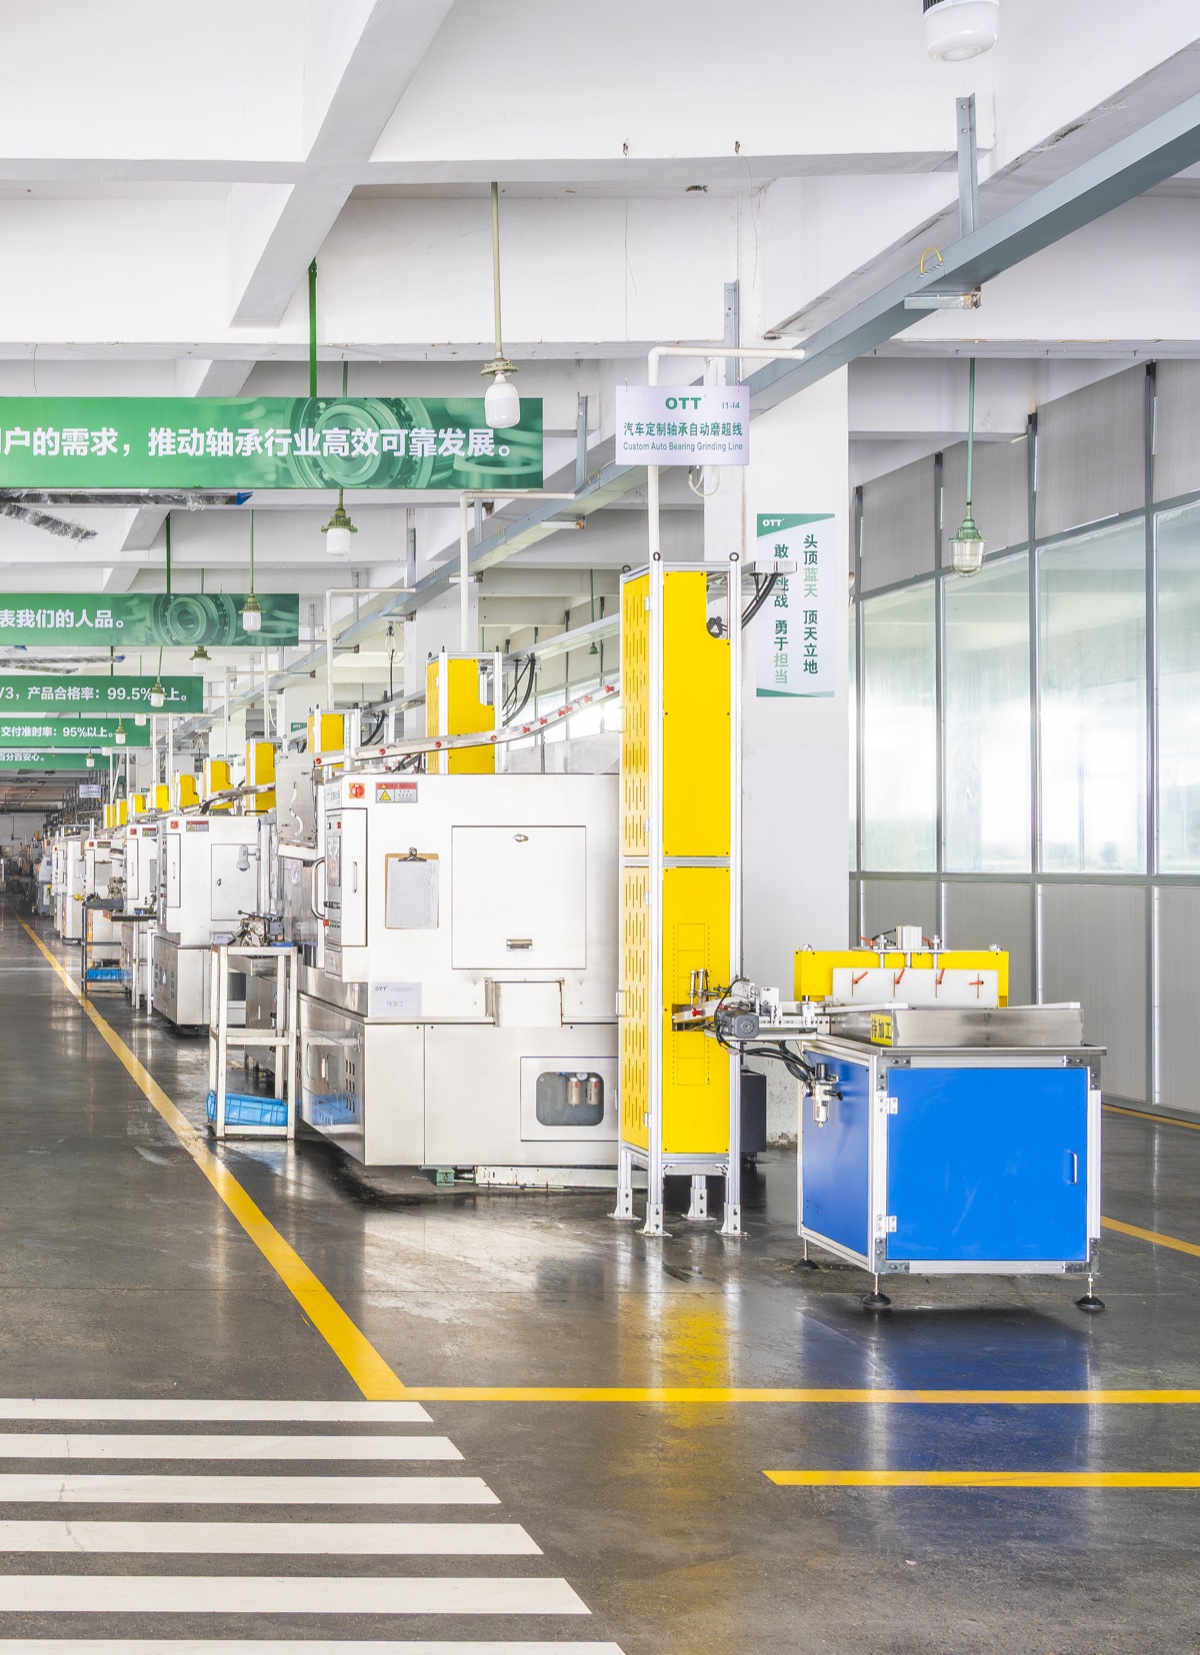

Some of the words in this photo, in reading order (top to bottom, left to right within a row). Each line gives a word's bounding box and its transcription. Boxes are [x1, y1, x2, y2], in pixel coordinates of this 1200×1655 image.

[665, 397, 702, 410] OTT
[624, 421, 743, 437] 汽车定制轴承自动磨超线
[623, 441, 649, 451] Custom
[651, 441, 667, 451] Auto
[669, 441, 695, 452] Bearing
[696, 441, 727, 453] Grinding
[728, 441, 743, 451] Line
[762, 518, 782, 527] OTT
[803, 534, 818, 599] 头顶蓝天
[803, 609, 819, 675] 顶天立地
[774, 619, 789, 685] 勇于担当
